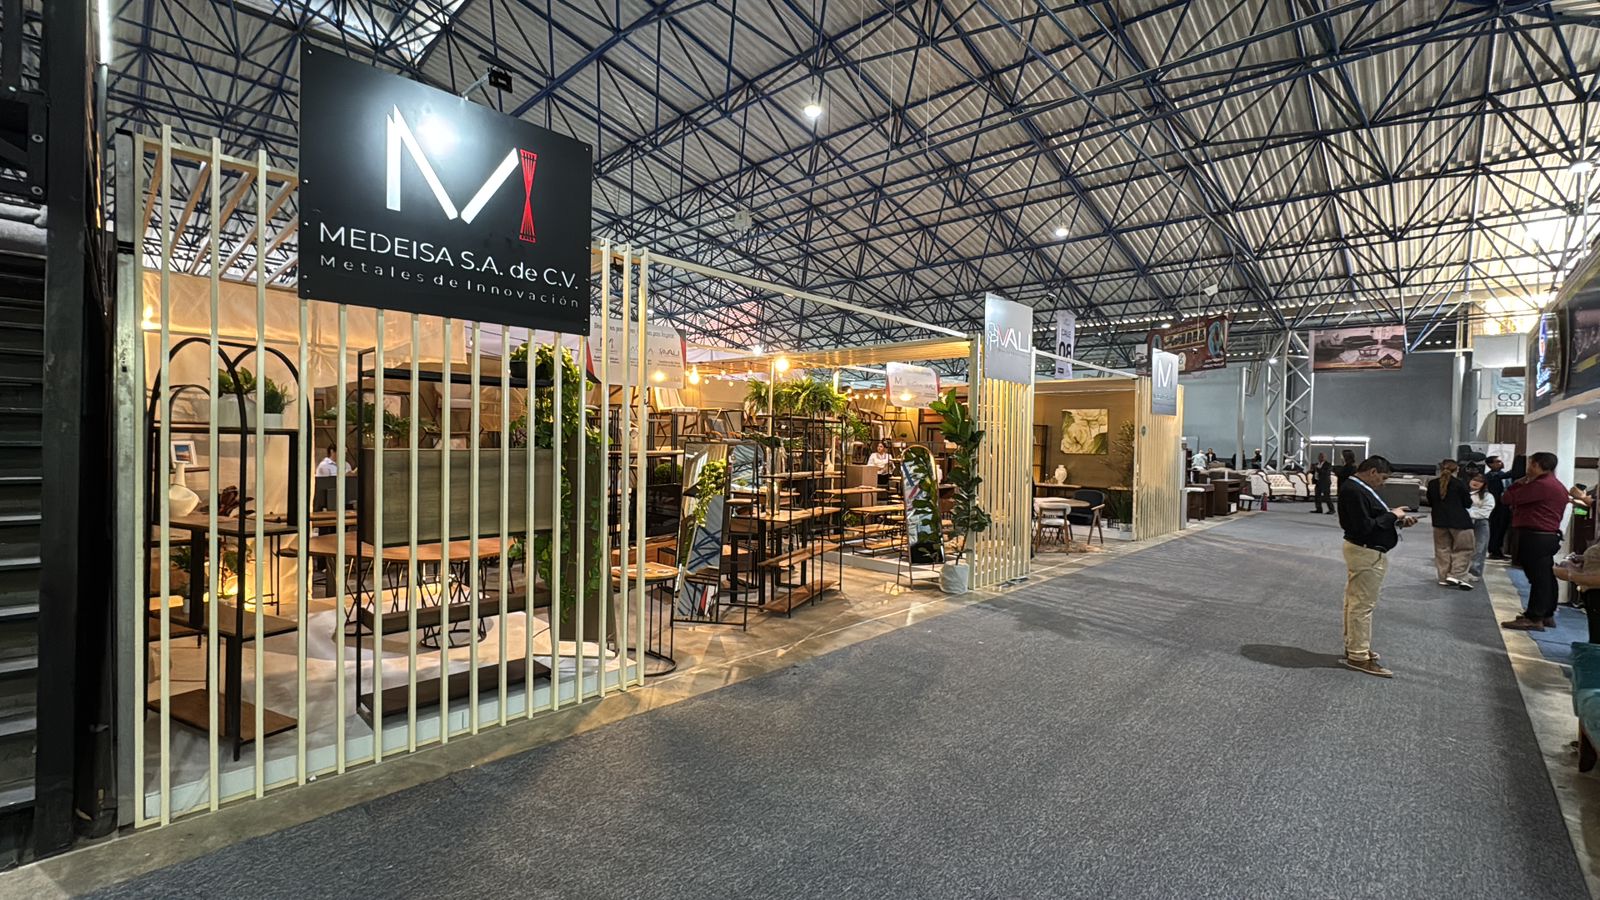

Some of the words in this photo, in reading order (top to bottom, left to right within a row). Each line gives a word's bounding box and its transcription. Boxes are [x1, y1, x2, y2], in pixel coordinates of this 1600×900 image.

[319, 222, 454, 267] MEDEISA
[460, 250, 504, 276] S.A.
[510, 262, 538, 282] de
[543, 267, 579, 290] C.V.
[320, 255, 425, 283] Metales
[433, 274, 458, 289] de
[466, 280, 580, 309] Innovación
[1497, 392, 1526, 402] CO
